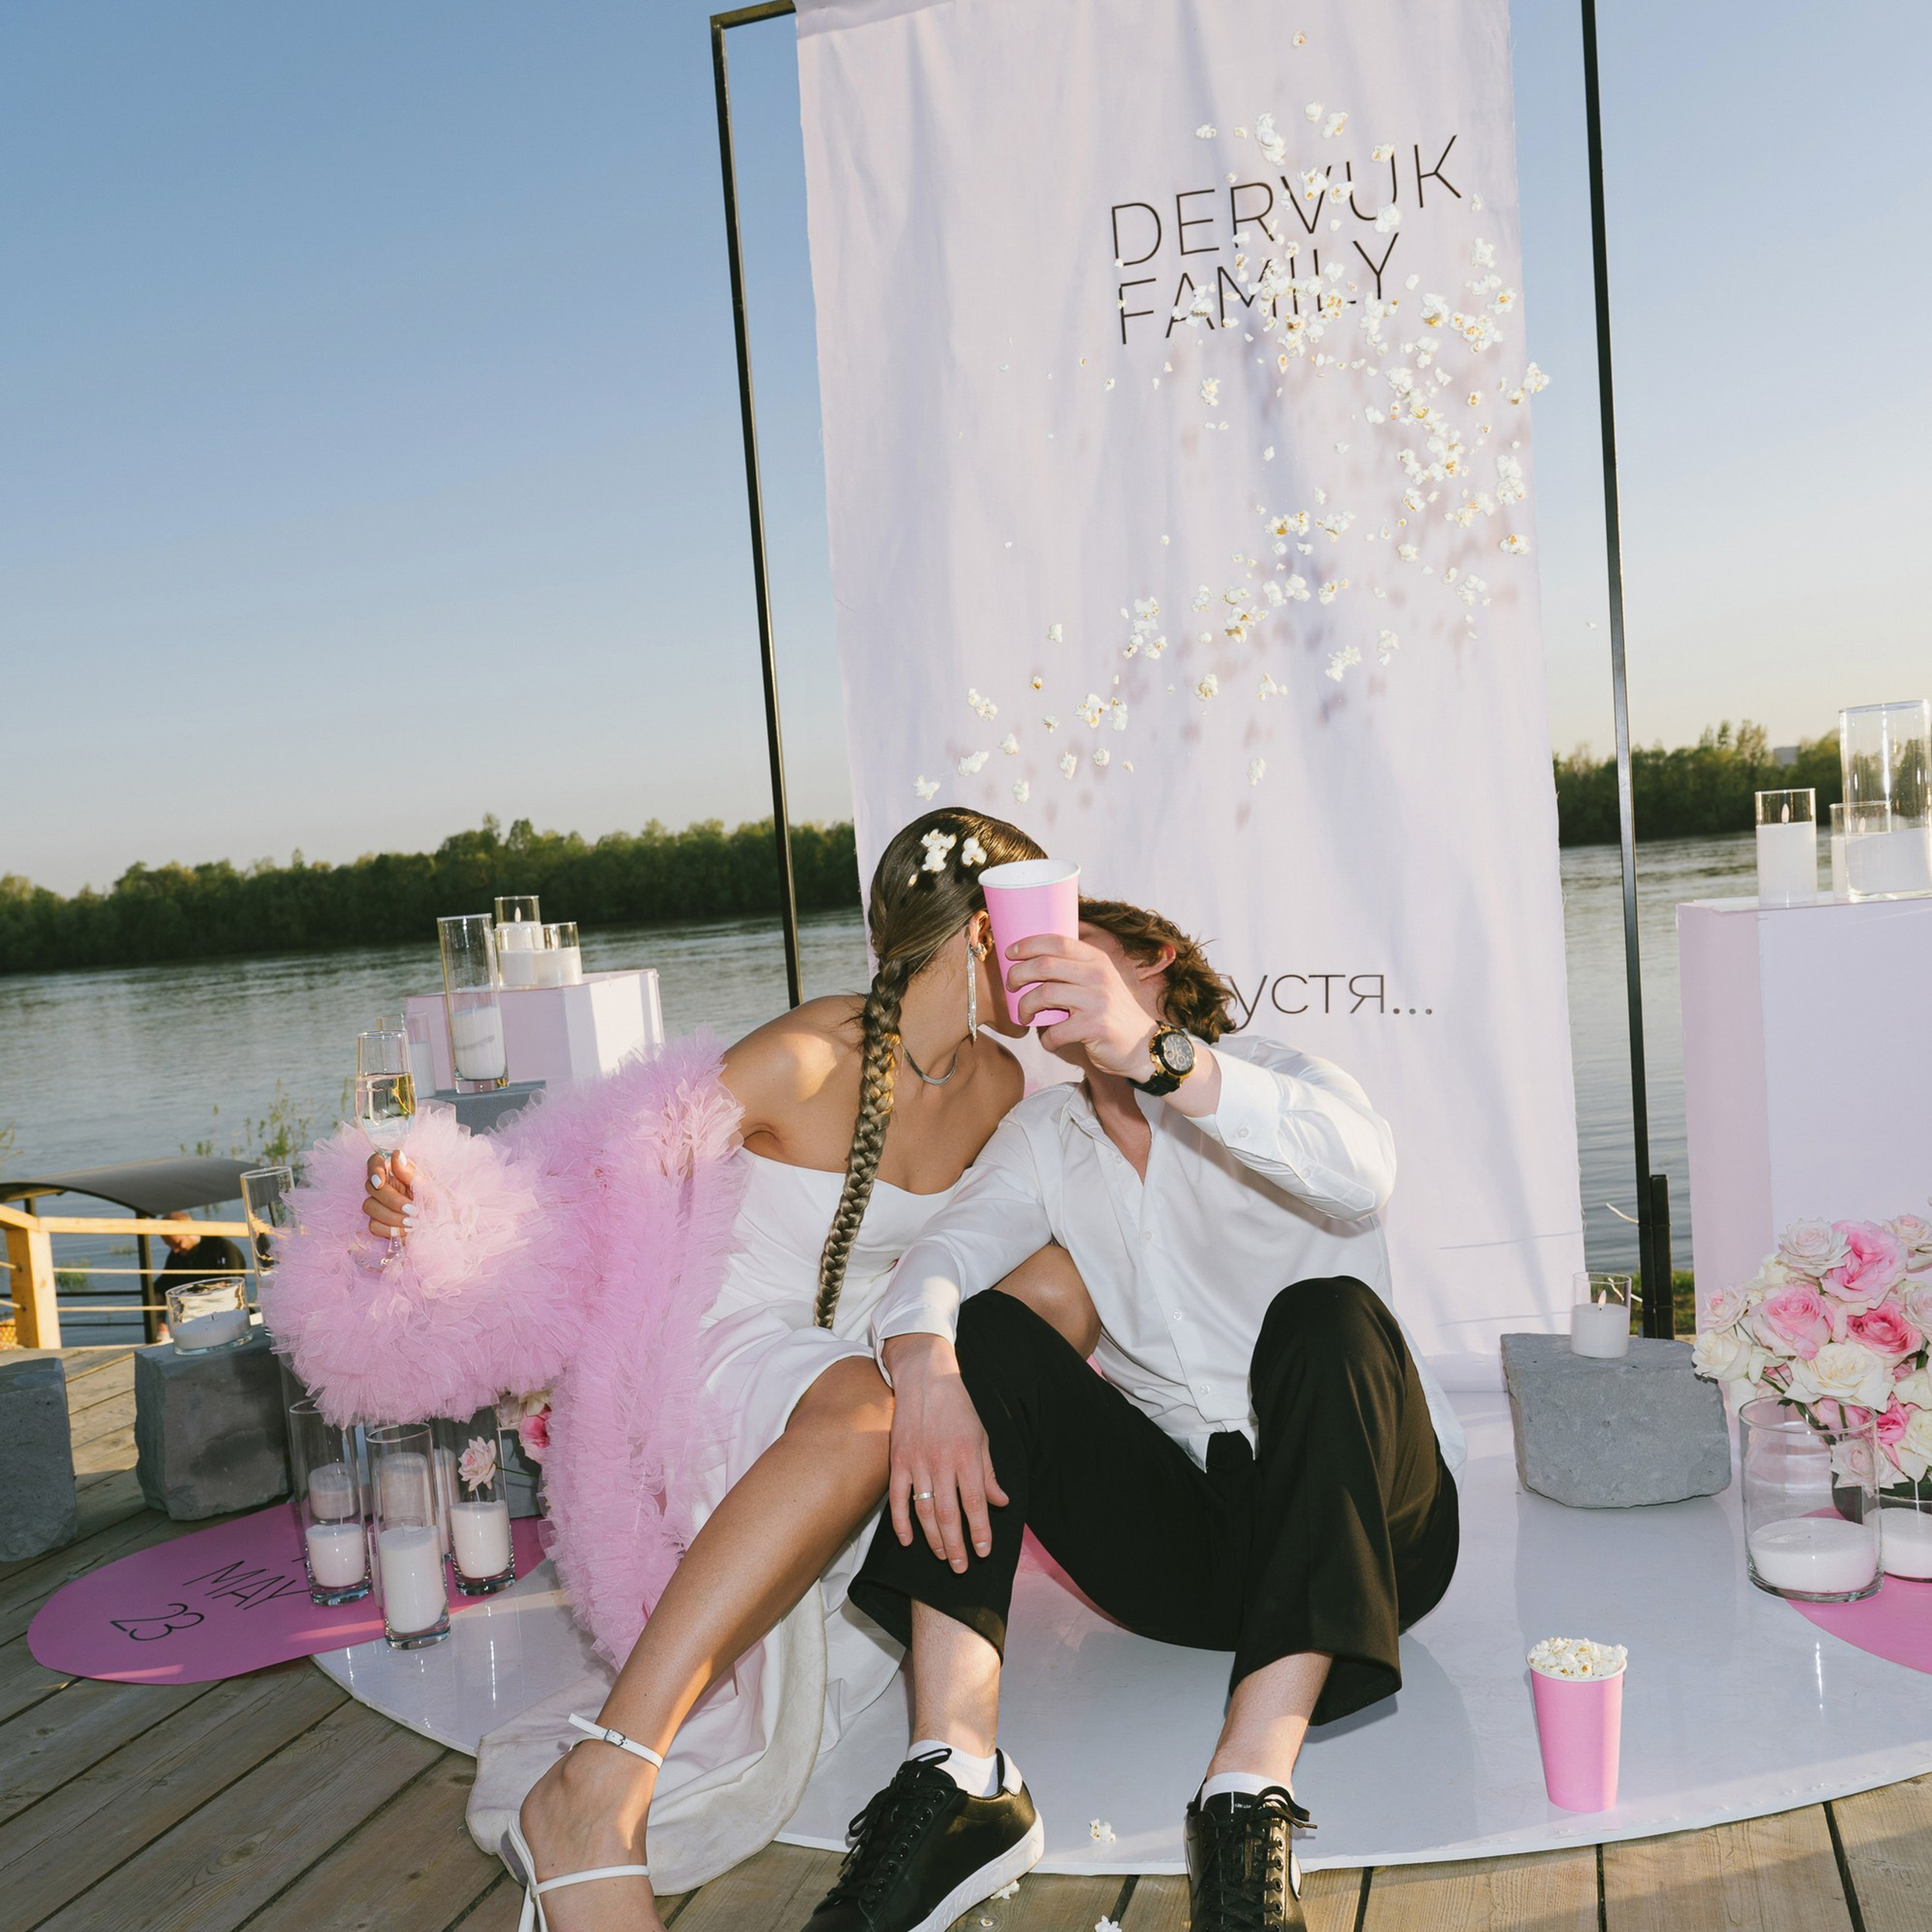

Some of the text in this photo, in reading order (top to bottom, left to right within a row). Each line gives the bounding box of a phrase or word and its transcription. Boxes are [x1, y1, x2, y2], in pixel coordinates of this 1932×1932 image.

[1111, 134, 1462, 266] DERVUK
[1118, 232, 1399, 344] FAMILY
[109, 1602, 205, 1641] 23
[182, 1560, 311, 1611] MAY
